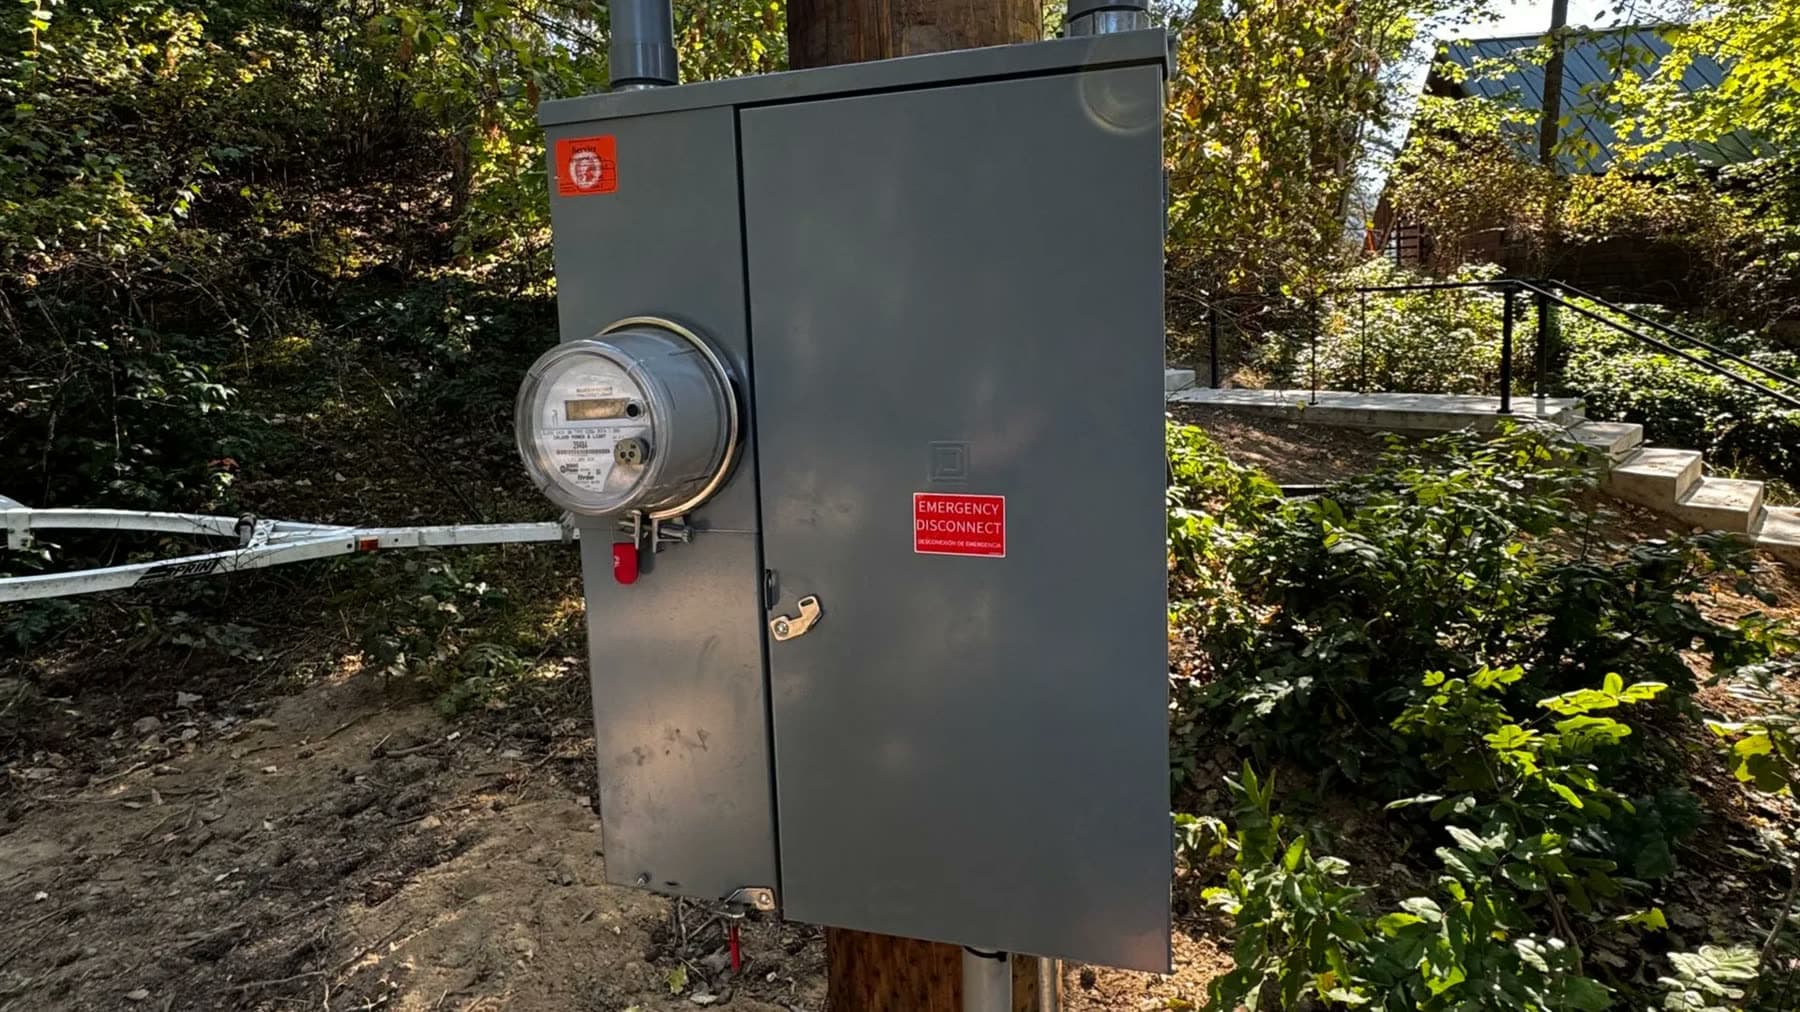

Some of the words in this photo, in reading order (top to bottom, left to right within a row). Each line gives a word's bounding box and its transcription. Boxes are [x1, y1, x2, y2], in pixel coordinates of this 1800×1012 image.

[918, 500, 1000, 516] EMERGENCY
[916, 519, 1002, 535] DISCONNECT
[965, 541, 1002, 549] EMERGENCIA
